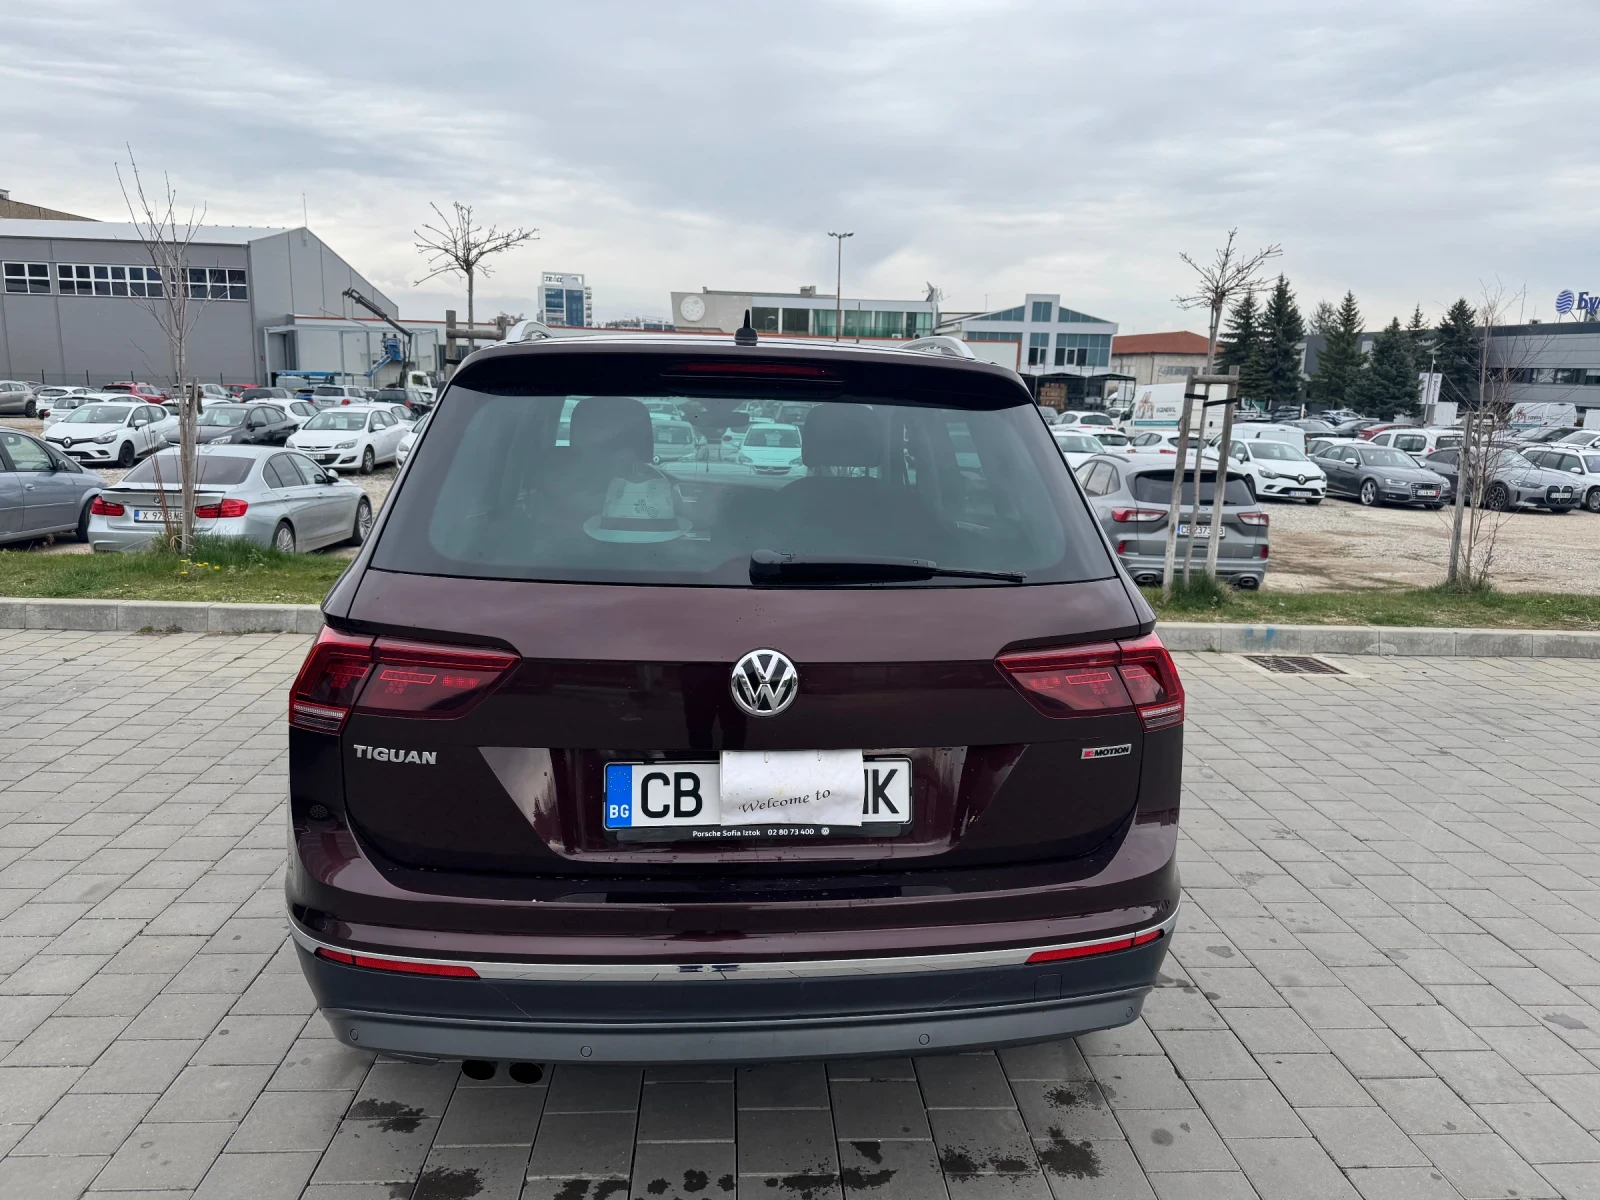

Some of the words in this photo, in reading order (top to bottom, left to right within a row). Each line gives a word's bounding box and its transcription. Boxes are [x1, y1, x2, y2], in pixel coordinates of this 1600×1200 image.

[1576, 291, 1600, 315] Бу
[142, 511, 149, 520] X
[353, 743, 438, 765] TIGUAN
[641, 771, 703, 818] CB
[738, 793, 810, 813] Welcome
[815, 789, 831, 801] to
[609, 804, 630, 818] BG
[692, 829, 721, 838] Porsche
[722, 829, 741, 837] Sofia
[742, 828, 761, 836] Iztok
[767, 828, 777, 836] 02
[778, 828, 788, 836] 80
[789, 828, 799, 836] 73
